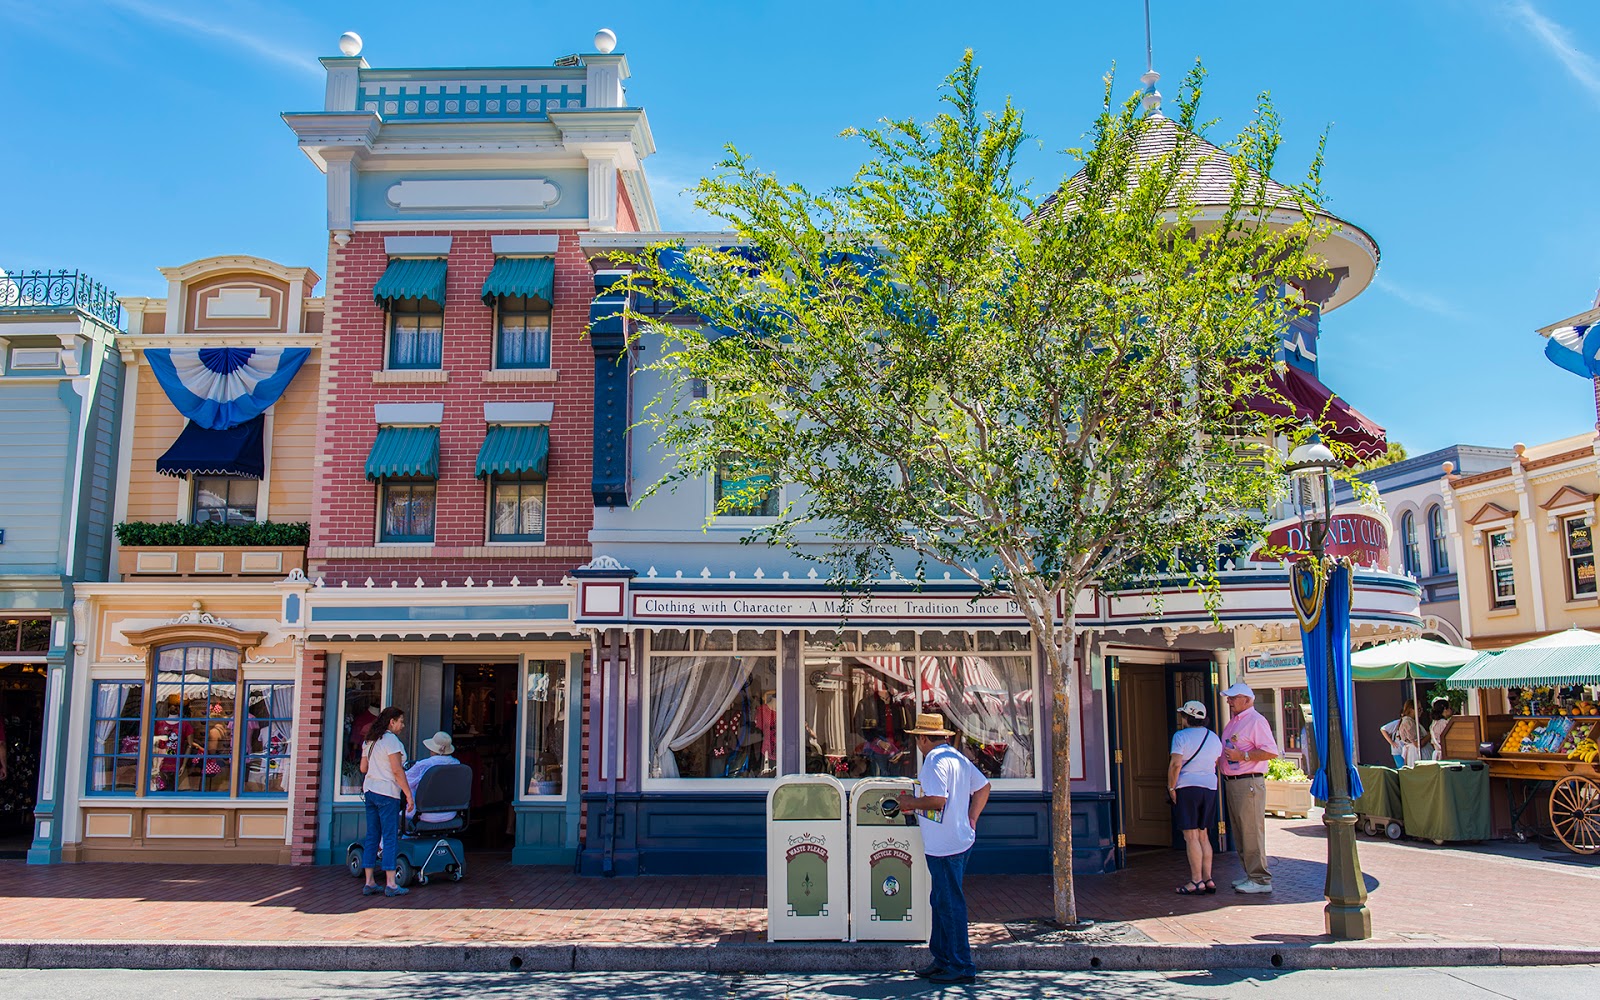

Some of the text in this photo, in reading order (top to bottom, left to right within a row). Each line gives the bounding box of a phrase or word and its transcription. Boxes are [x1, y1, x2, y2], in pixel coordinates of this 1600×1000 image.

[1287, 518, 1357, 556] DINEY
[645, 599, 696, 614] Clothing
[702, 600, 727, 613] with
[733, 600, 793, 613] Character
[808, 601, 817, 613] A
[860, 600, 898, 614] Street
[904, 601, 959, 614] Tradition
[965, 601, 999, 614] Since
[788, 845, 827, 857] WASTE PLEASE
